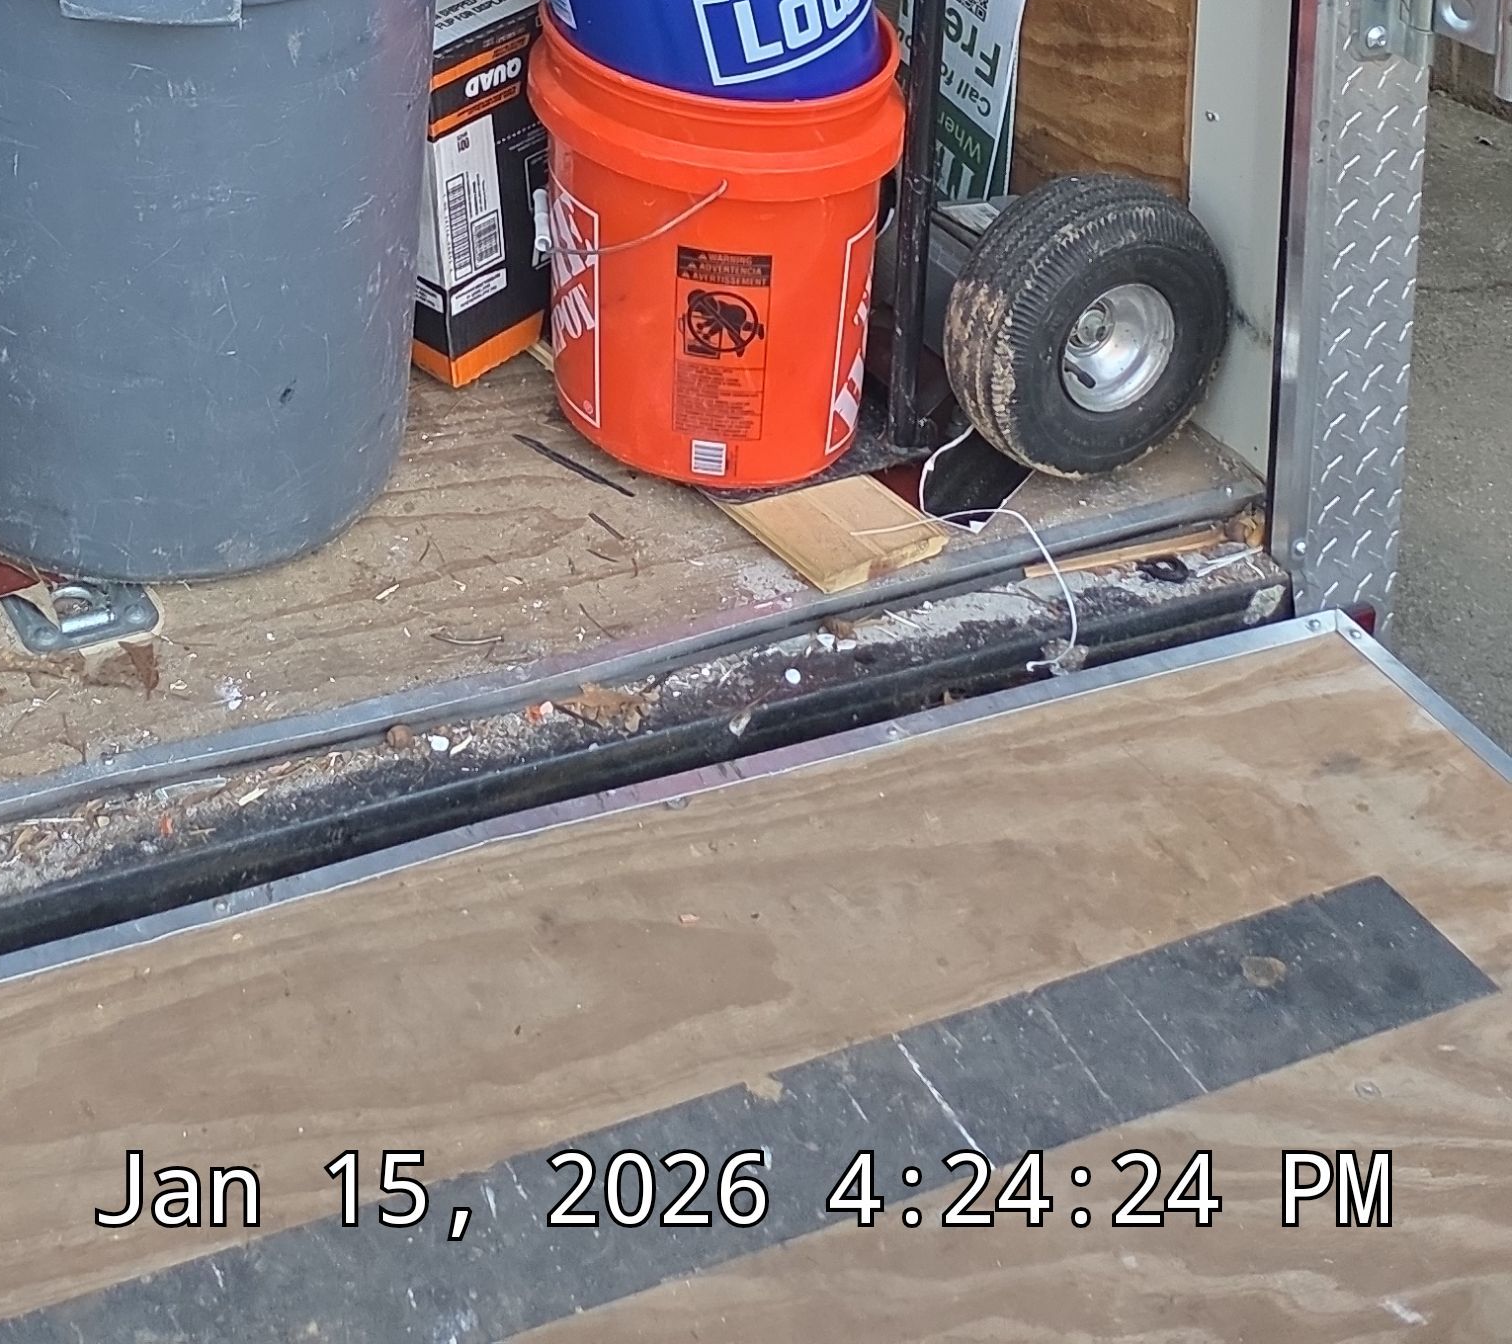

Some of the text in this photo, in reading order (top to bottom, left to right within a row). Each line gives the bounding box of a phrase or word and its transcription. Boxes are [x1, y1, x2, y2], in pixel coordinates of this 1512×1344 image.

[945, 6, 1001, 88] Fre
[464, 56, 522, 98] QUAD
[956, 80, 992, 118] Call
[938, 115, 982, 164] Wher
[699, 263, 762, 276] ADVERTENCIA
[708, 253, 753, 265] WARNING
[693, 272, 769, 286] AVERTISSEMENT
